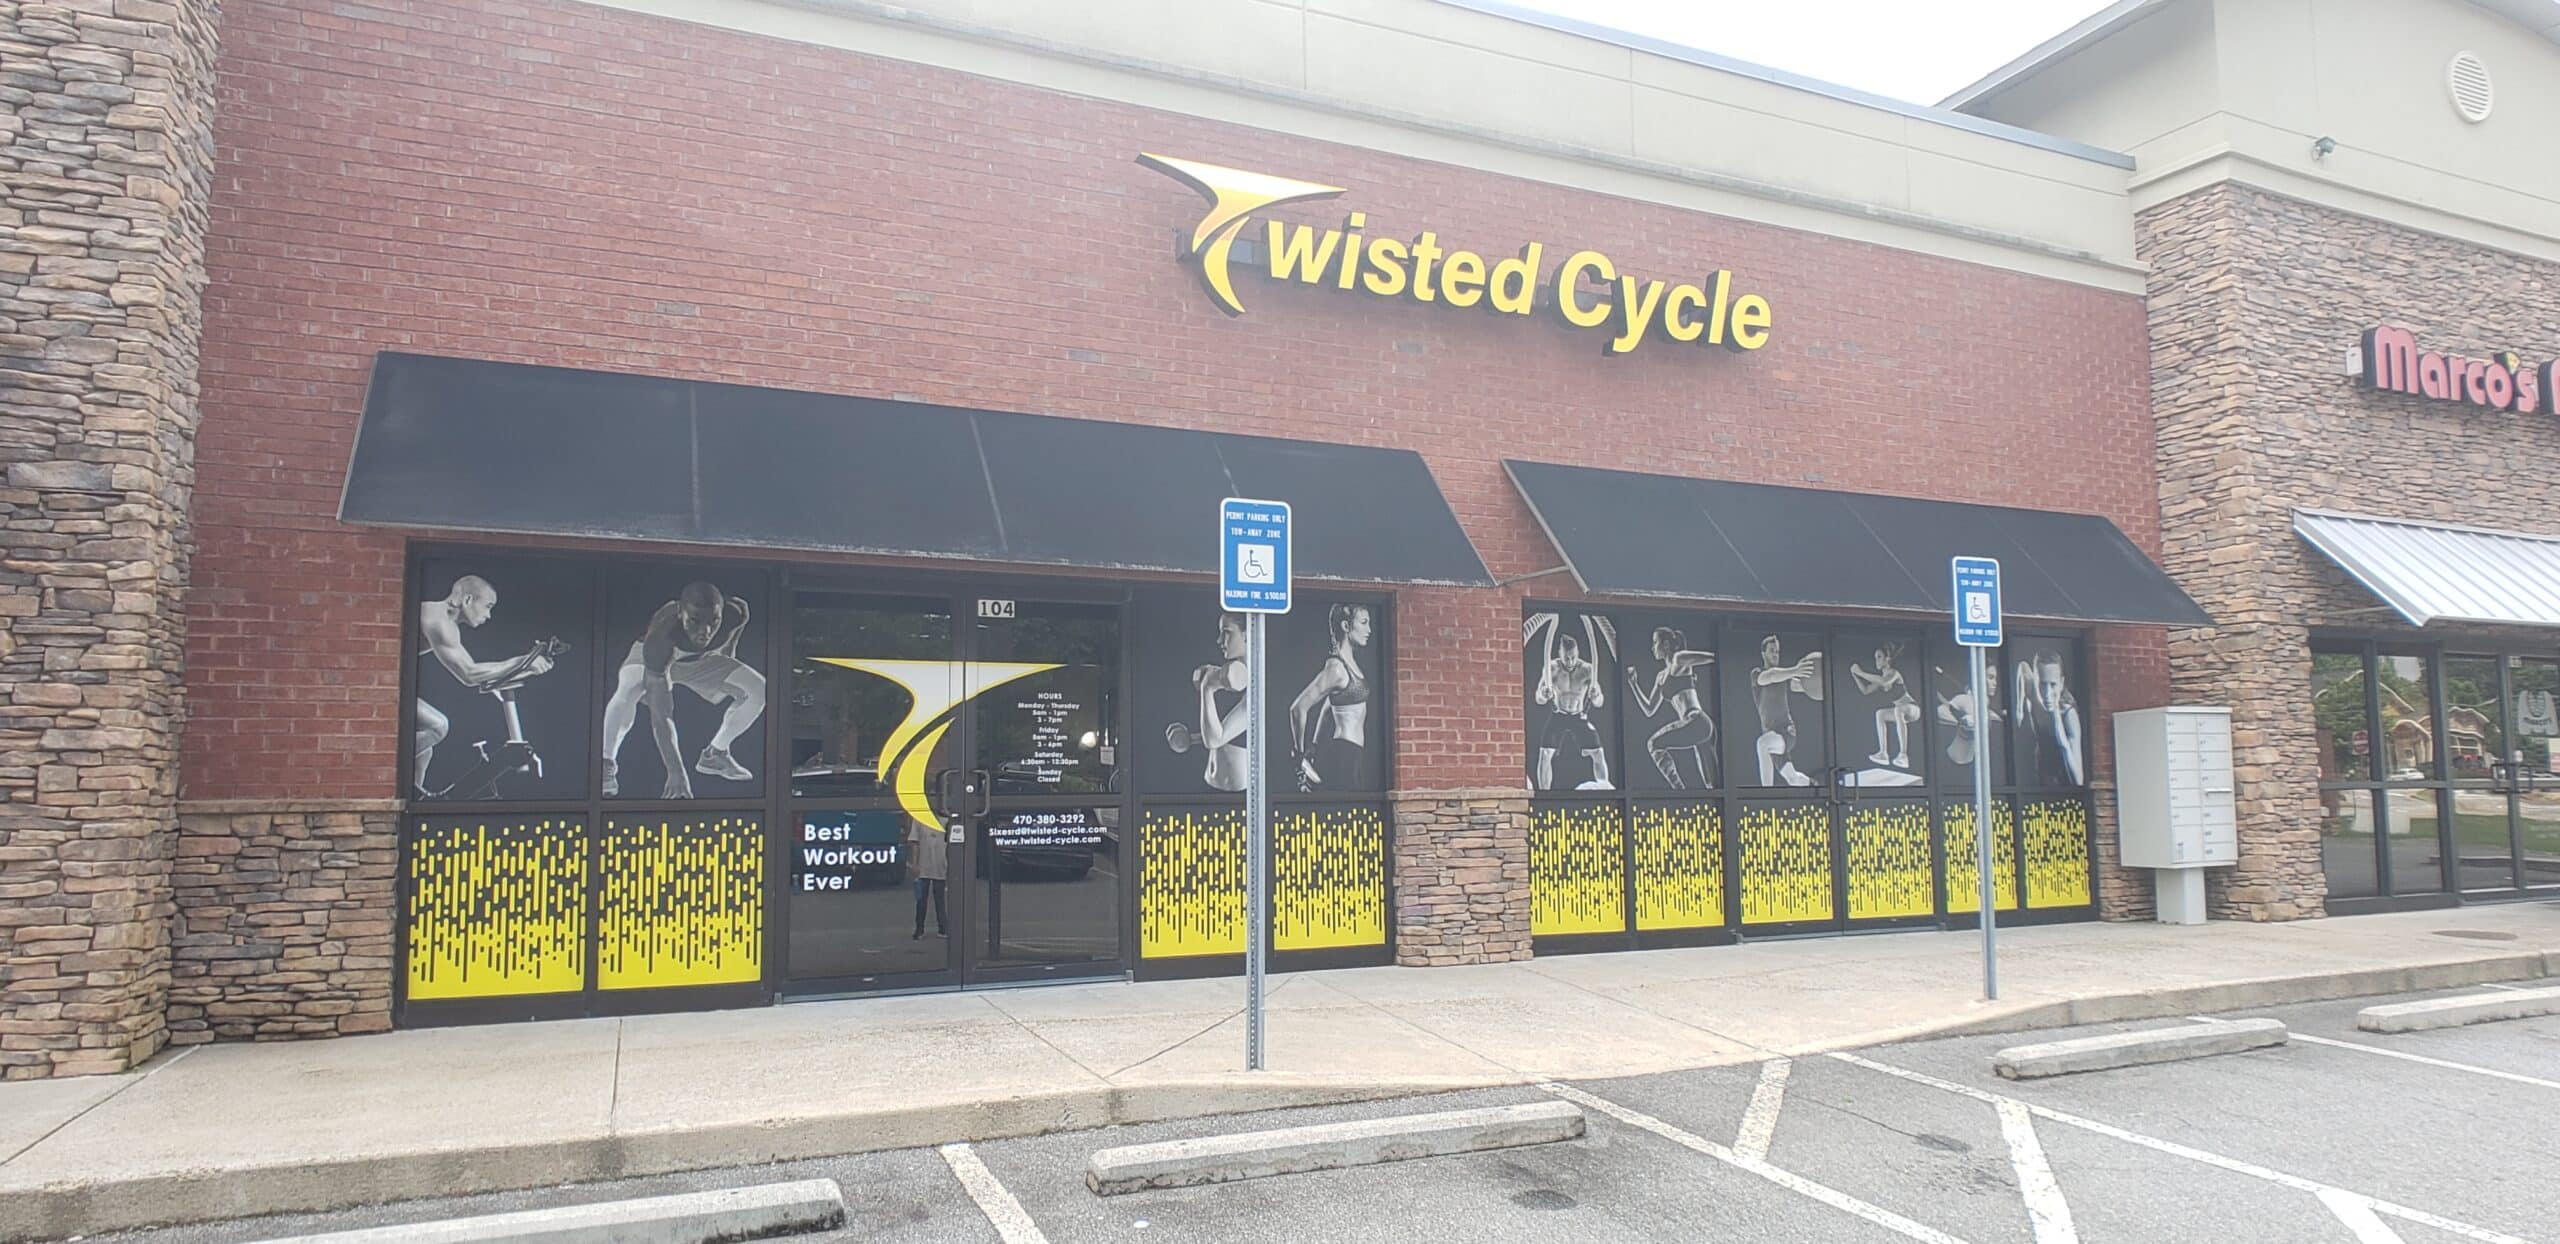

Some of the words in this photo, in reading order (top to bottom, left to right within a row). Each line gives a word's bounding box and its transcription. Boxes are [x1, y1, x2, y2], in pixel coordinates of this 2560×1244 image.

[1138, 152, 1543, 315] Twisted
[1557, 250, 1772, 353] Cycle
[2373, 323, 2540, 414] Marco's
[1247, 512, 1270, 522] PARKING
[1271, 514, 1286, 523] ONLY
[1266, 529, 1281, 538] ZONE
[980, 601, 1014, 617] 104
[1038, 692, 1062, 700] HOURS
[1018, 702, 1045, 710] Monday
[1051, 702, 1080, 710] Thursday
[1053, 709, 1068, 717] 1pm
[1048, 716, 1063, 724] 7pm
[1039, 726, 1059, 734] Friday
[1053, 733, 1068, 741] 1pm
[1038, 768, 1062, 776] Sunday
[1012, 813, 1086, 825] 470-380-3292
[804, 823, 851, 841] Best
[995, 835, 1102, 846] Www.twisted-cycle.com
[803, 846, 897, 866] Workout
[803, 873, 852, 891] Ever
